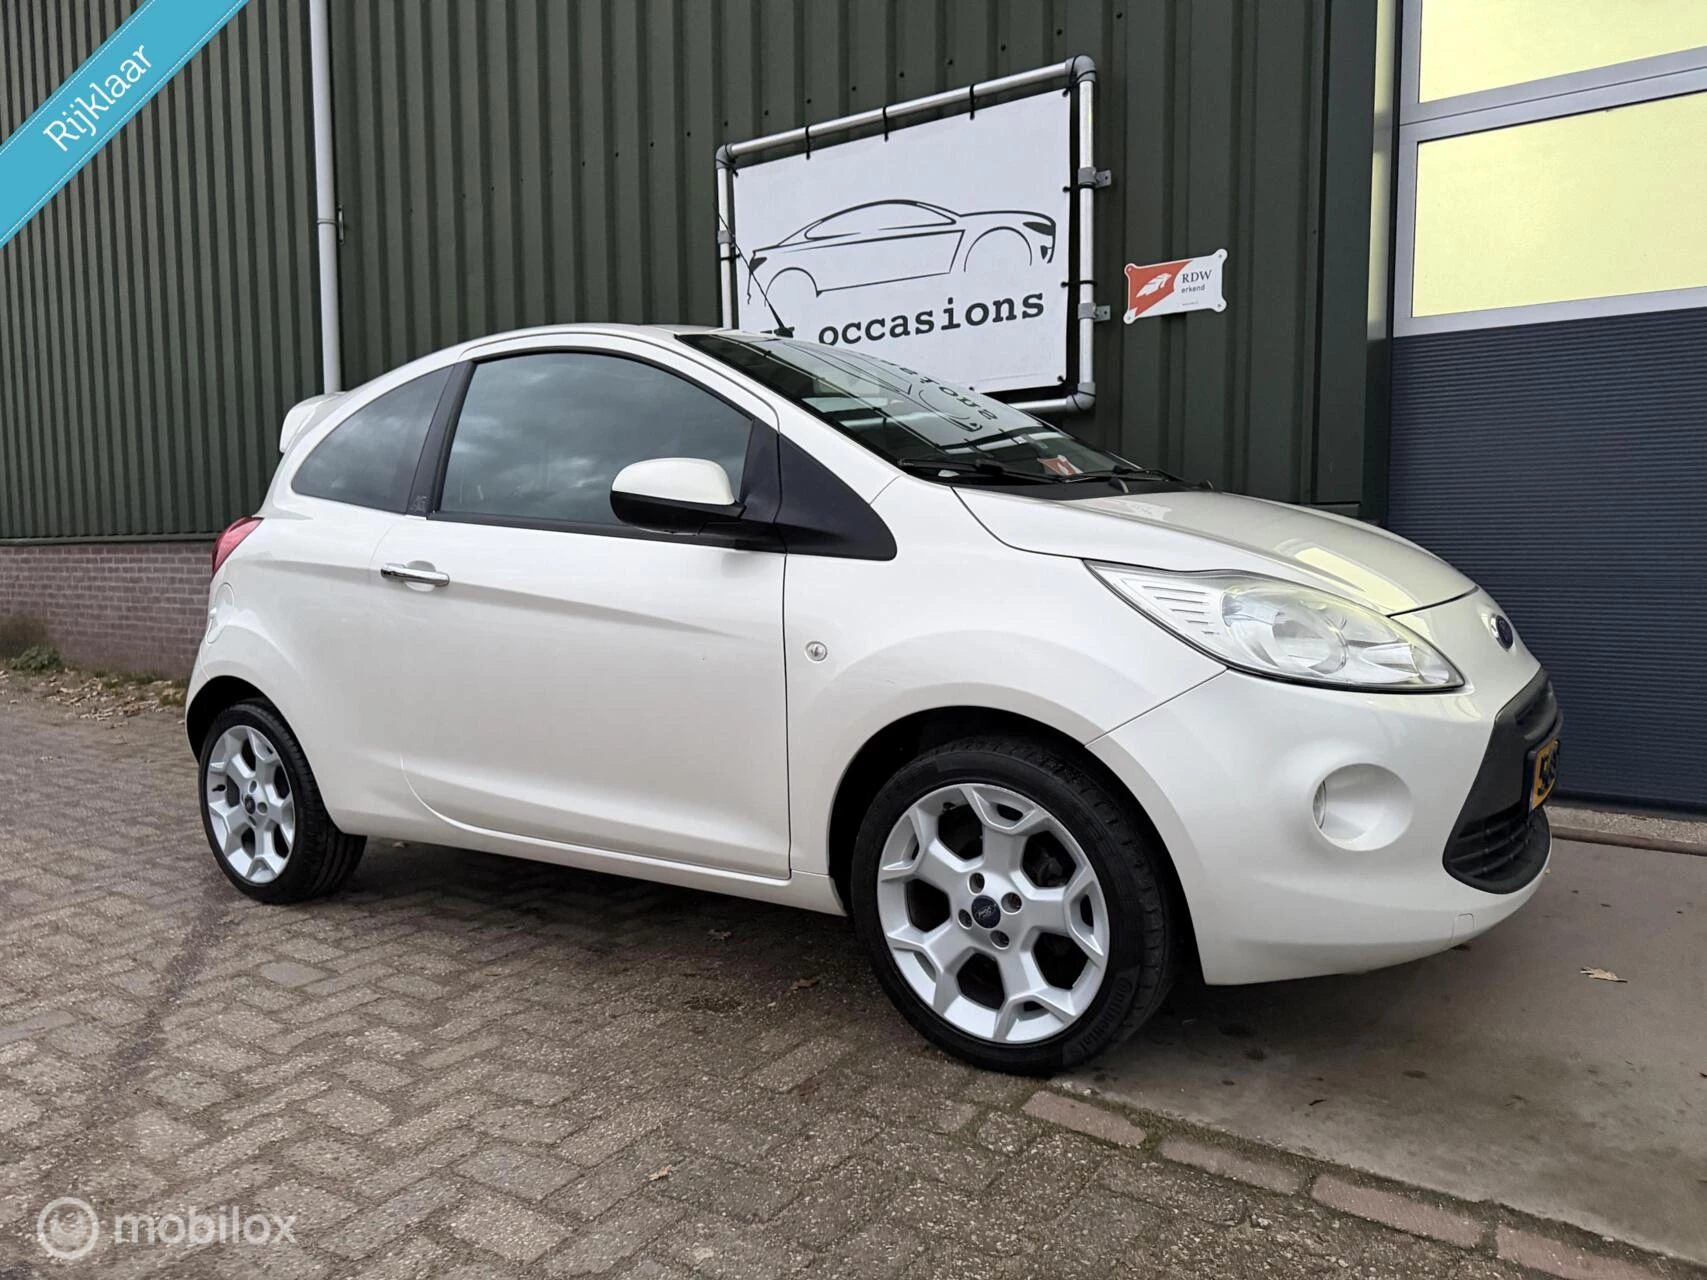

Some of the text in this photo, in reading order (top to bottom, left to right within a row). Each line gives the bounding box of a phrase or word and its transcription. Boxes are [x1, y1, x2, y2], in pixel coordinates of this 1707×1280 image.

[1181, 268, 1213, 284] RDW
[1181, 284, 1206, 294] erkend
[818, 292, 1045, 346] occasions
